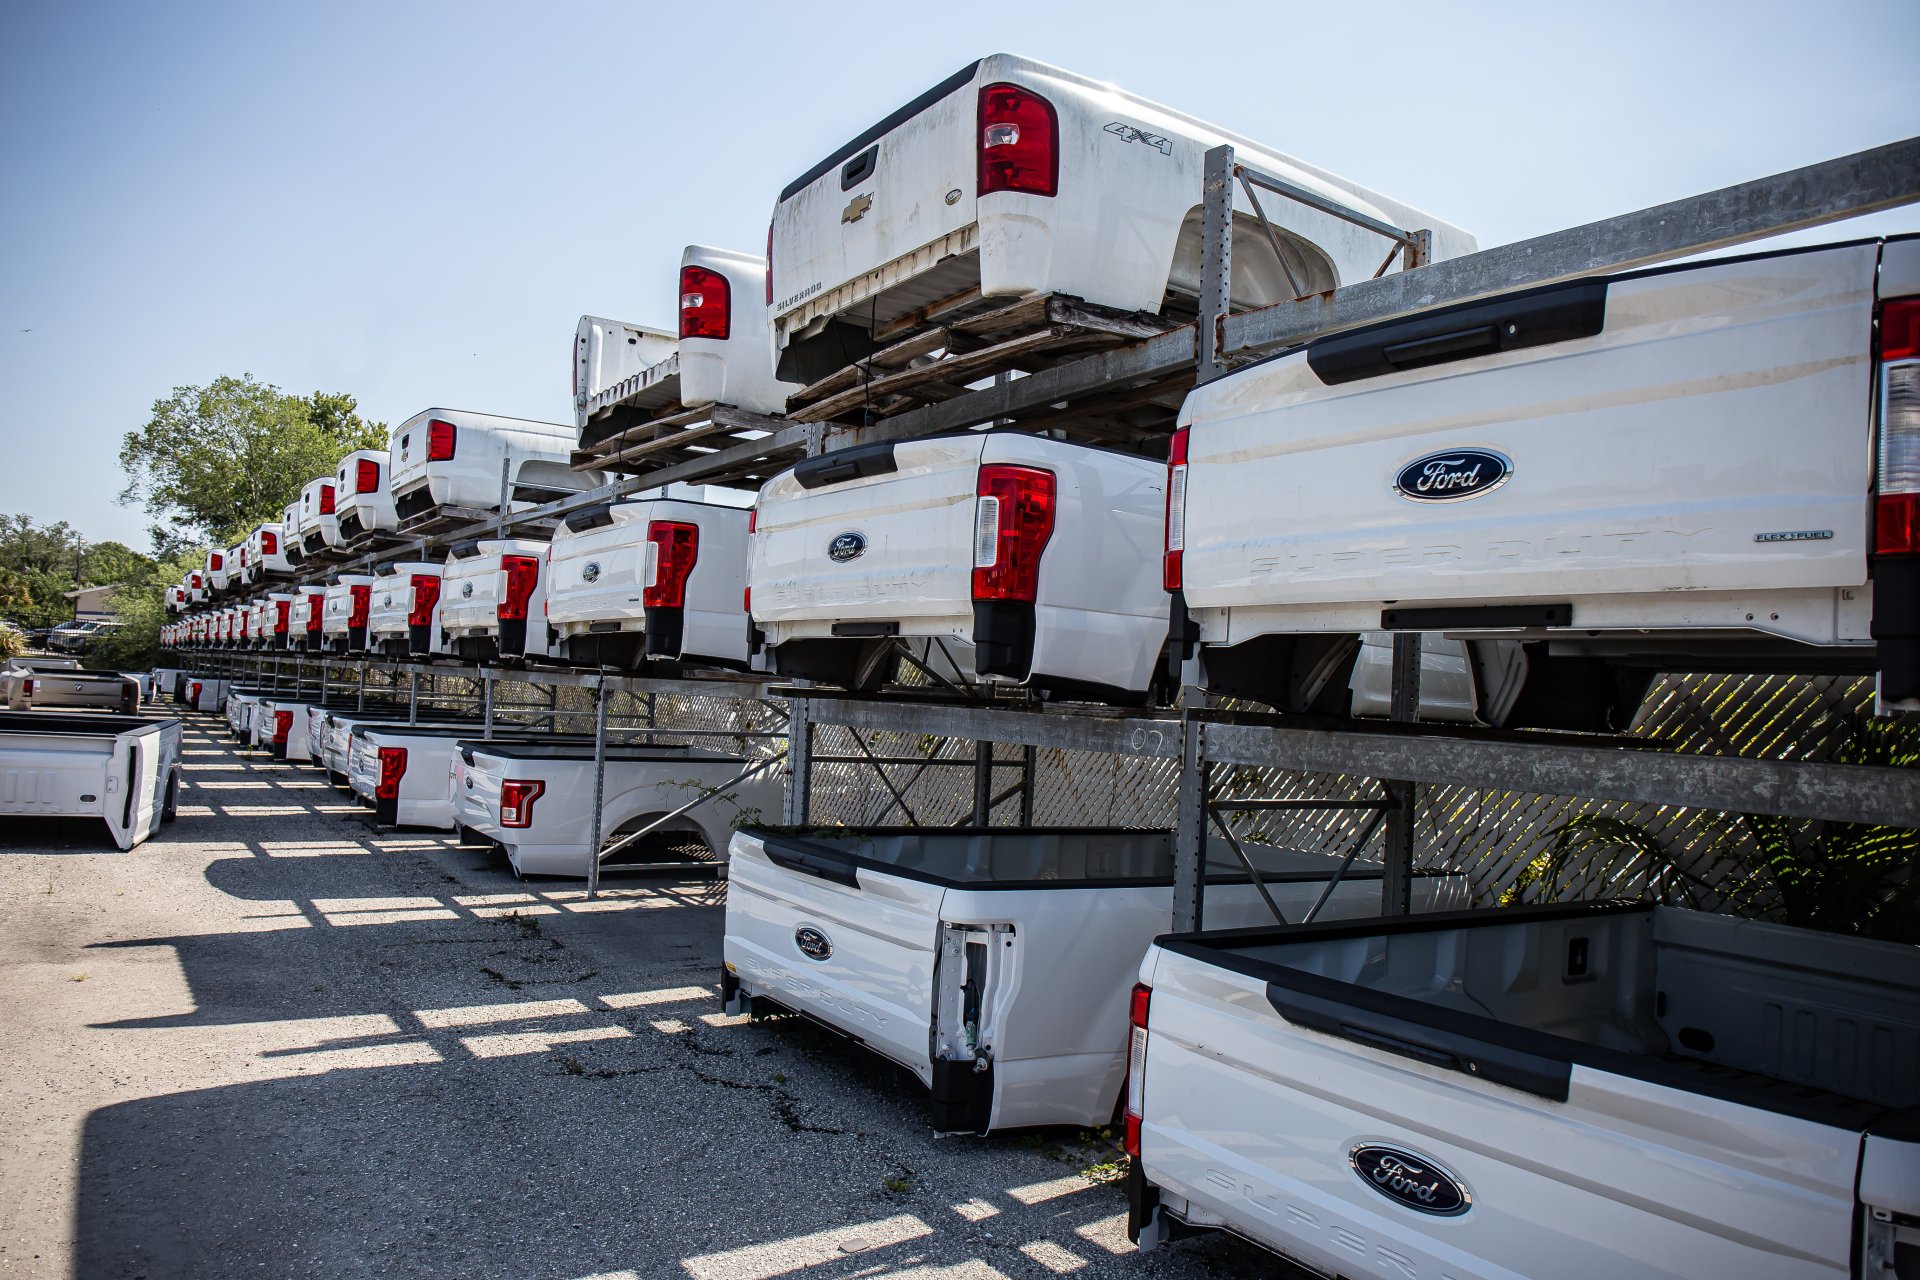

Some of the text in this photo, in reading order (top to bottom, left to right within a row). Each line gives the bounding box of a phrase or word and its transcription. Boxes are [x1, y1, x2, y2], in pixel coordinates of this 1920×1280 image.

[776, 281, 822, 312] SILVERADO
[1416, 458, 1482, 491] Ford
[833, 537, 857, 556] Ford
[800, 931, 822, 954] Ford
[1372, 1155, 1440, 1203] Ford
[1206, 1168, 1417, 1280] SUPER
